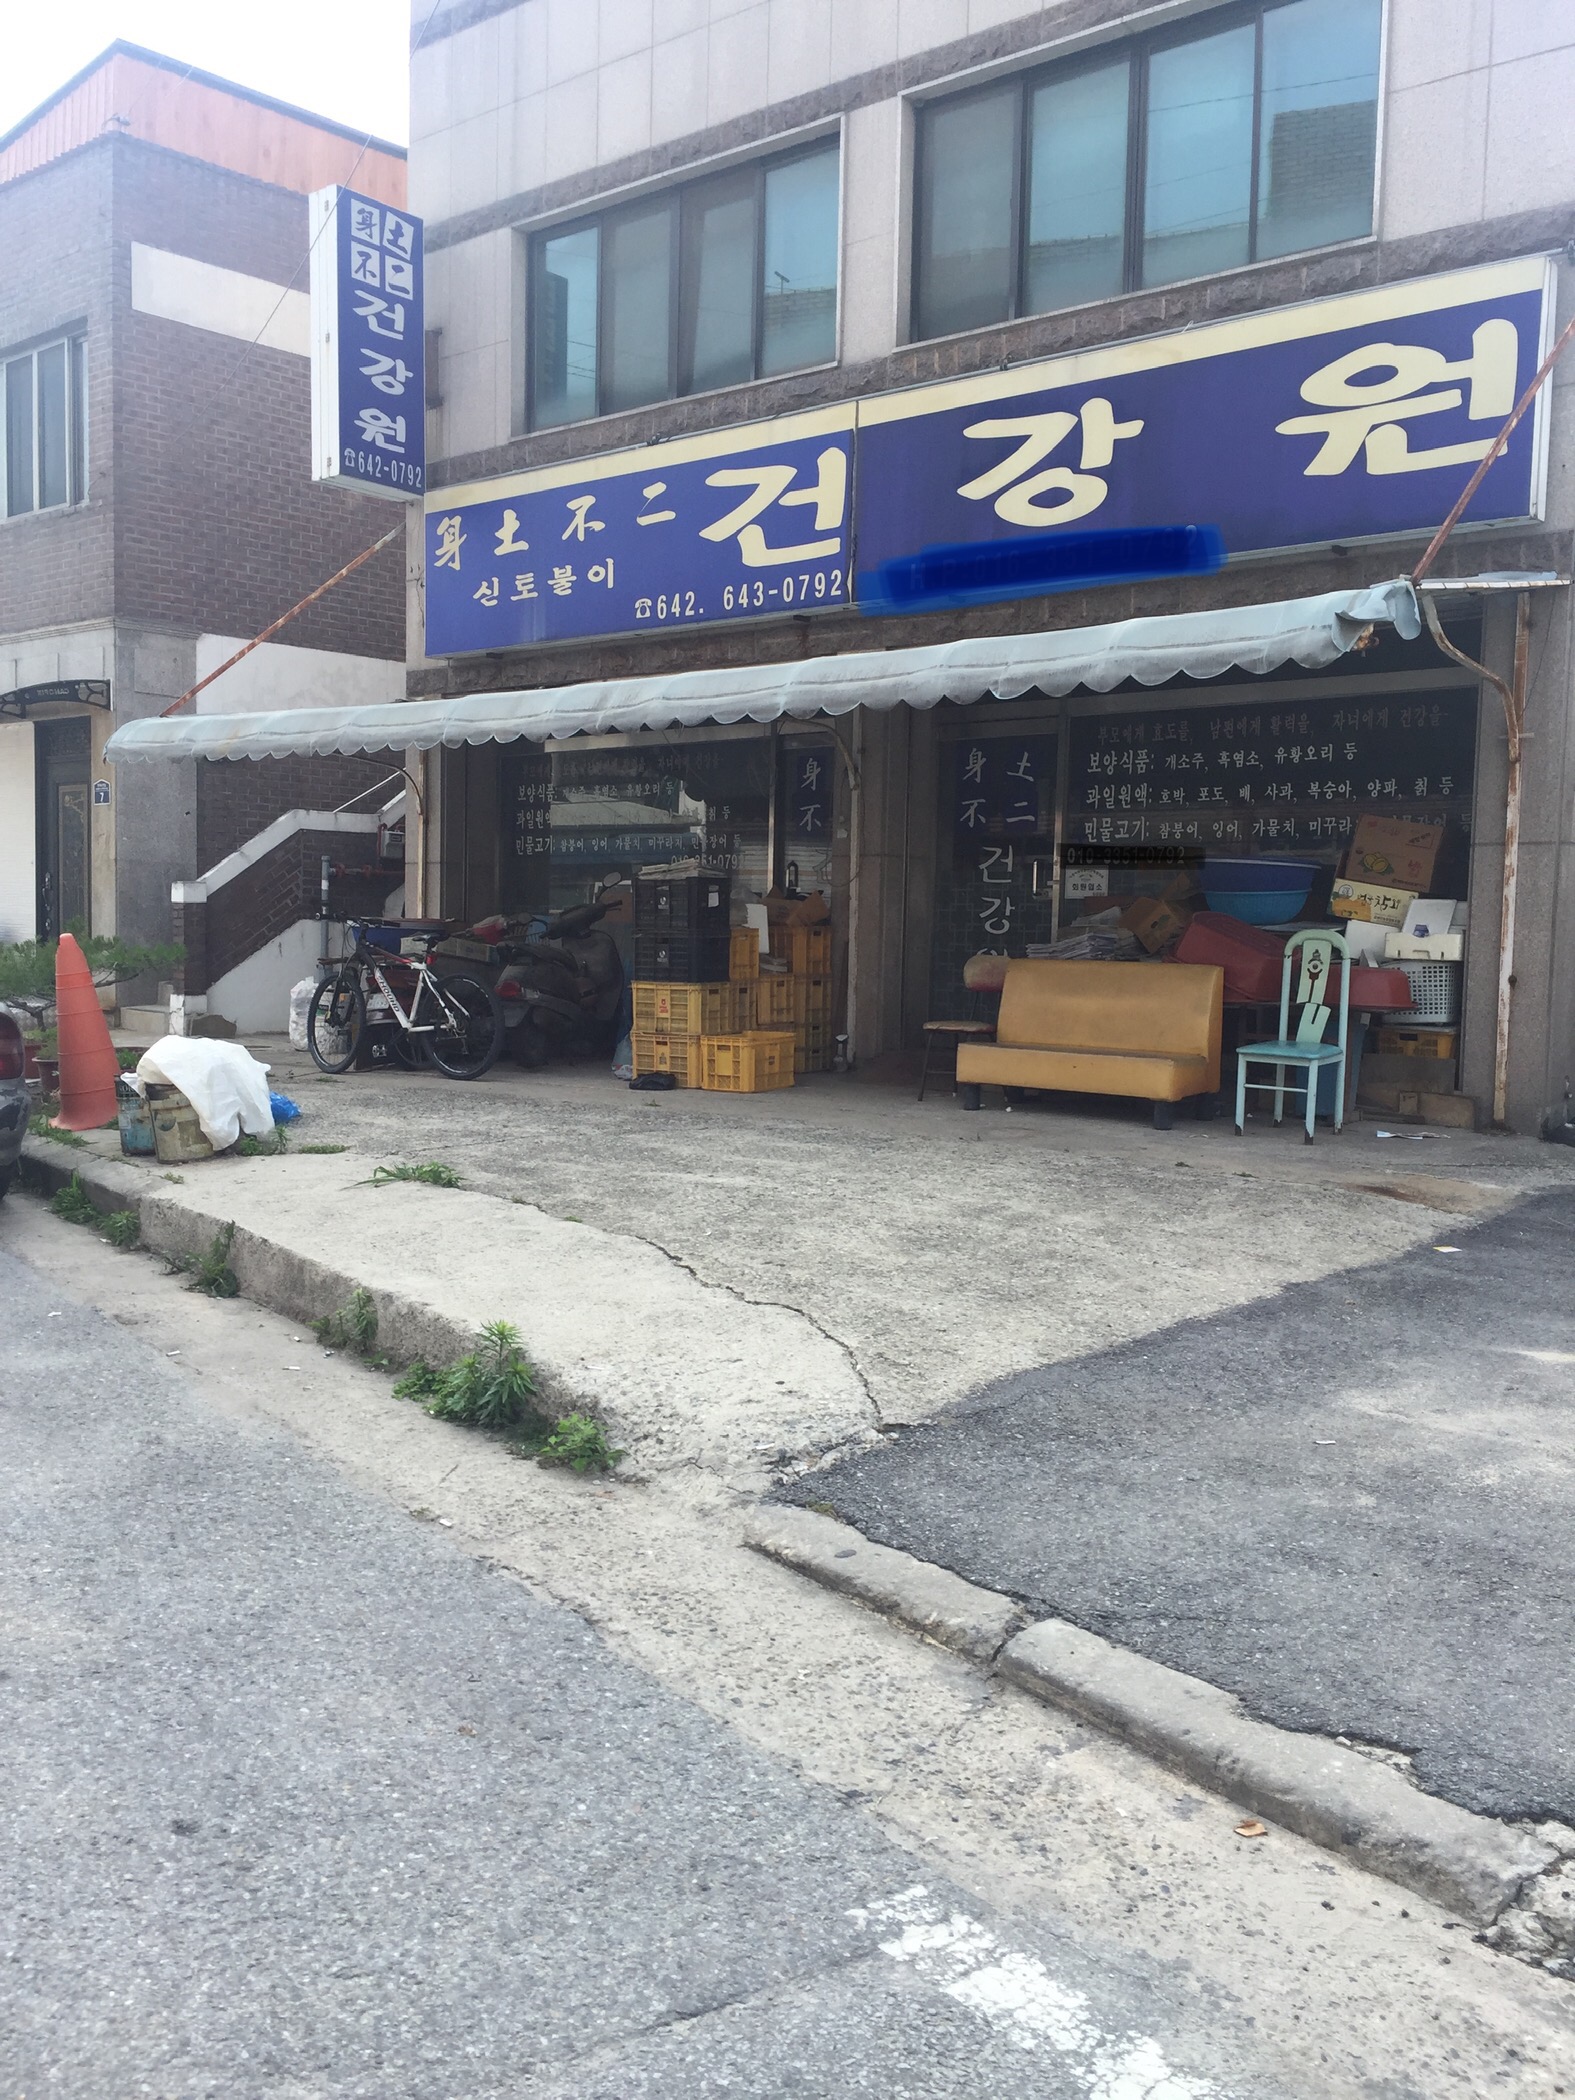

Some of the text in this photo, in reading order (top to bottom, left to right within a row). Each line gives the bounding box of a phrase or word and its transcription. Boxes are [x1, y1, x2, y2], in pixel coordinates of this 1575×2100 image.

[352, 289, 414, 454] 건강원
[357, 450, 422, 488] 642-0792
[473, 558, 615, 607] 신토불이
[657, 569, 843, 620] 642. 643-0792
[1087, 742, 1358, 776] 보양식품: 개소주, 흑염소, 유황오리 등
[99, 792, 104, 803] 7
[665, 781, 674, 796] 등
[1086, 776, 1455, 810] 과일원액: 호박, 포도, 배, 사과, 복숭아, 양파, 칡 등
[722, 805, 731, 821] 등
[733, 834, 741, 848] 등
[1084, 815, 1149, 843] 민물고기:
[1159, 821, 1203, 842] 참붕어,
[1212, 819, 1243, 841] 잉어,
[1251, 817, 1300, 840] 가물치,
[1072, 883, 1103, 891] 회원업소
